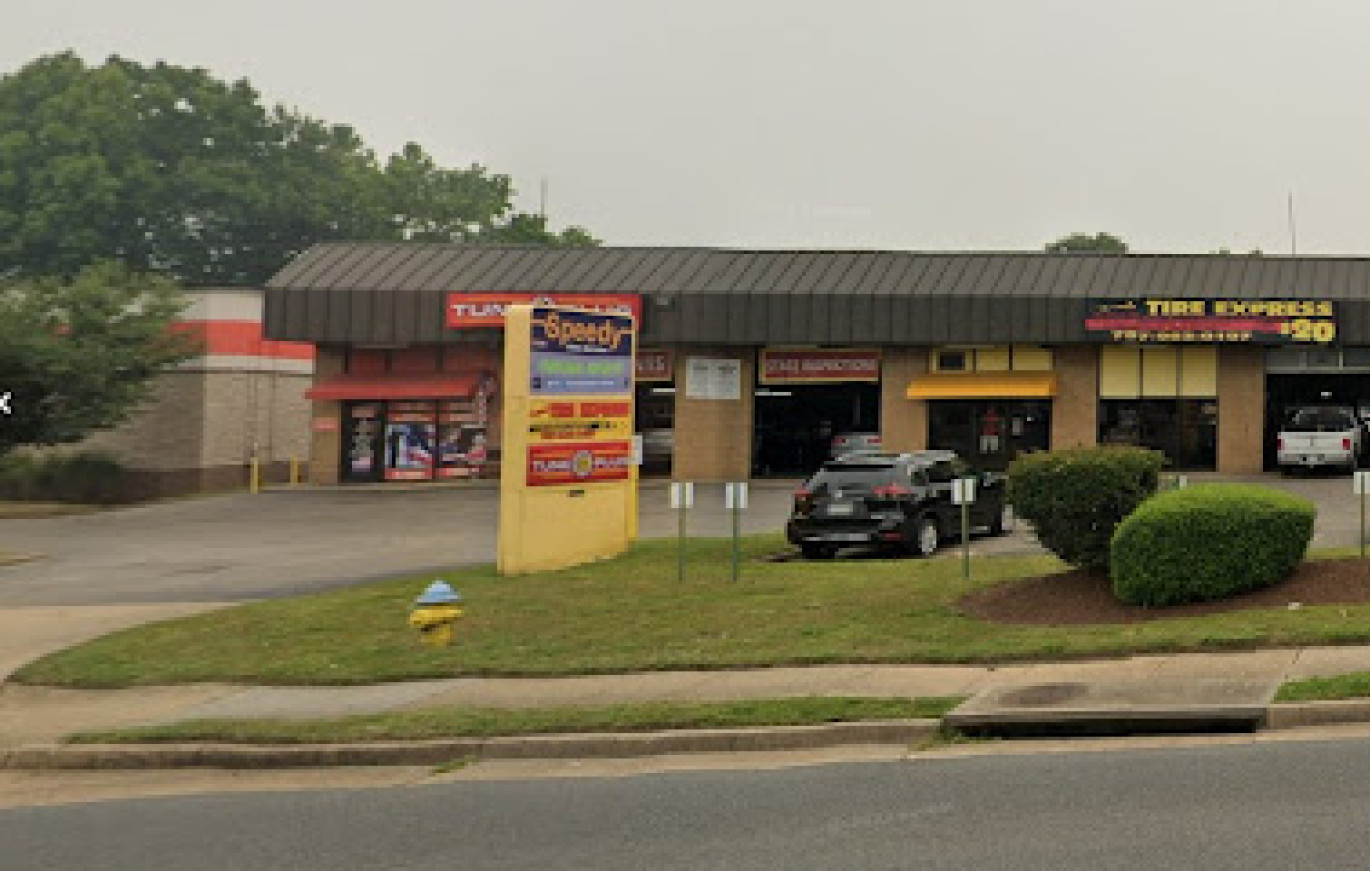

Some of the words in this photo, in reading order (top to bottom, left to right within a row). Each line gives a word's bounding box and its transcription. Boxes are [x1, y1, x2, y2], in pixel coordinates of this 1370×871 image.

[1145, 300, 1205, 317] TIRE
[1213, 300, 1333, 317] EXPRESS
[543, 312, 622, 351] Speedy
